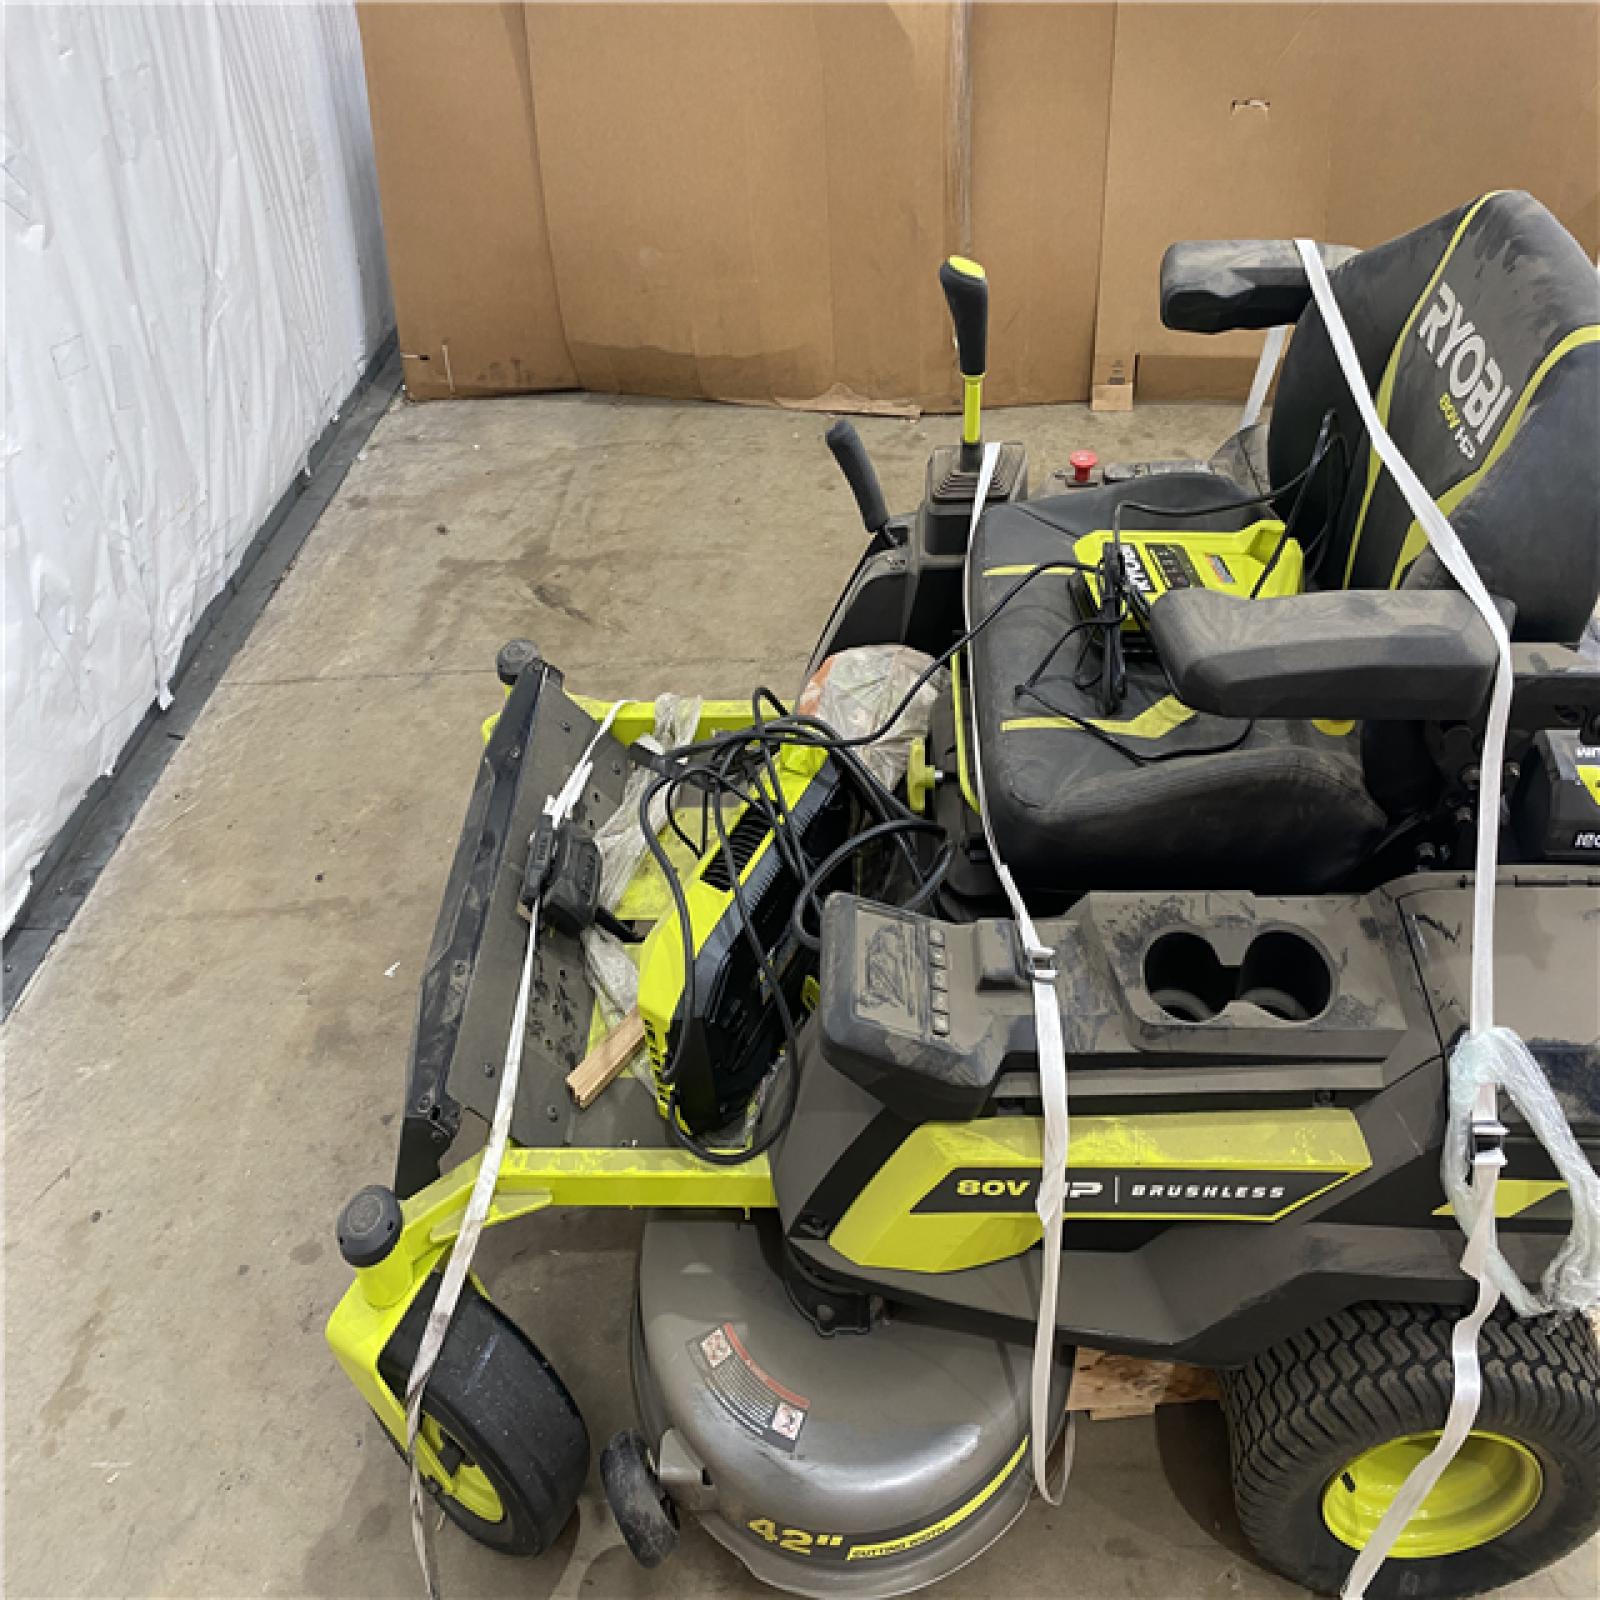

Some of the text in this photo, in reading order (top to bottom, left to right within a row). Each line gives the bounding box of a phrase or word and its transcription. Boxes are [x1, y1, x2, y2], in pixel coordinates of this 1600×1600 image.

[1419, 282, 1512, 443] RYOBI
[957, 1179, 1286, 1199] 80V P BRUSHLESS
[747, 1518, 843, 1555] 42"
